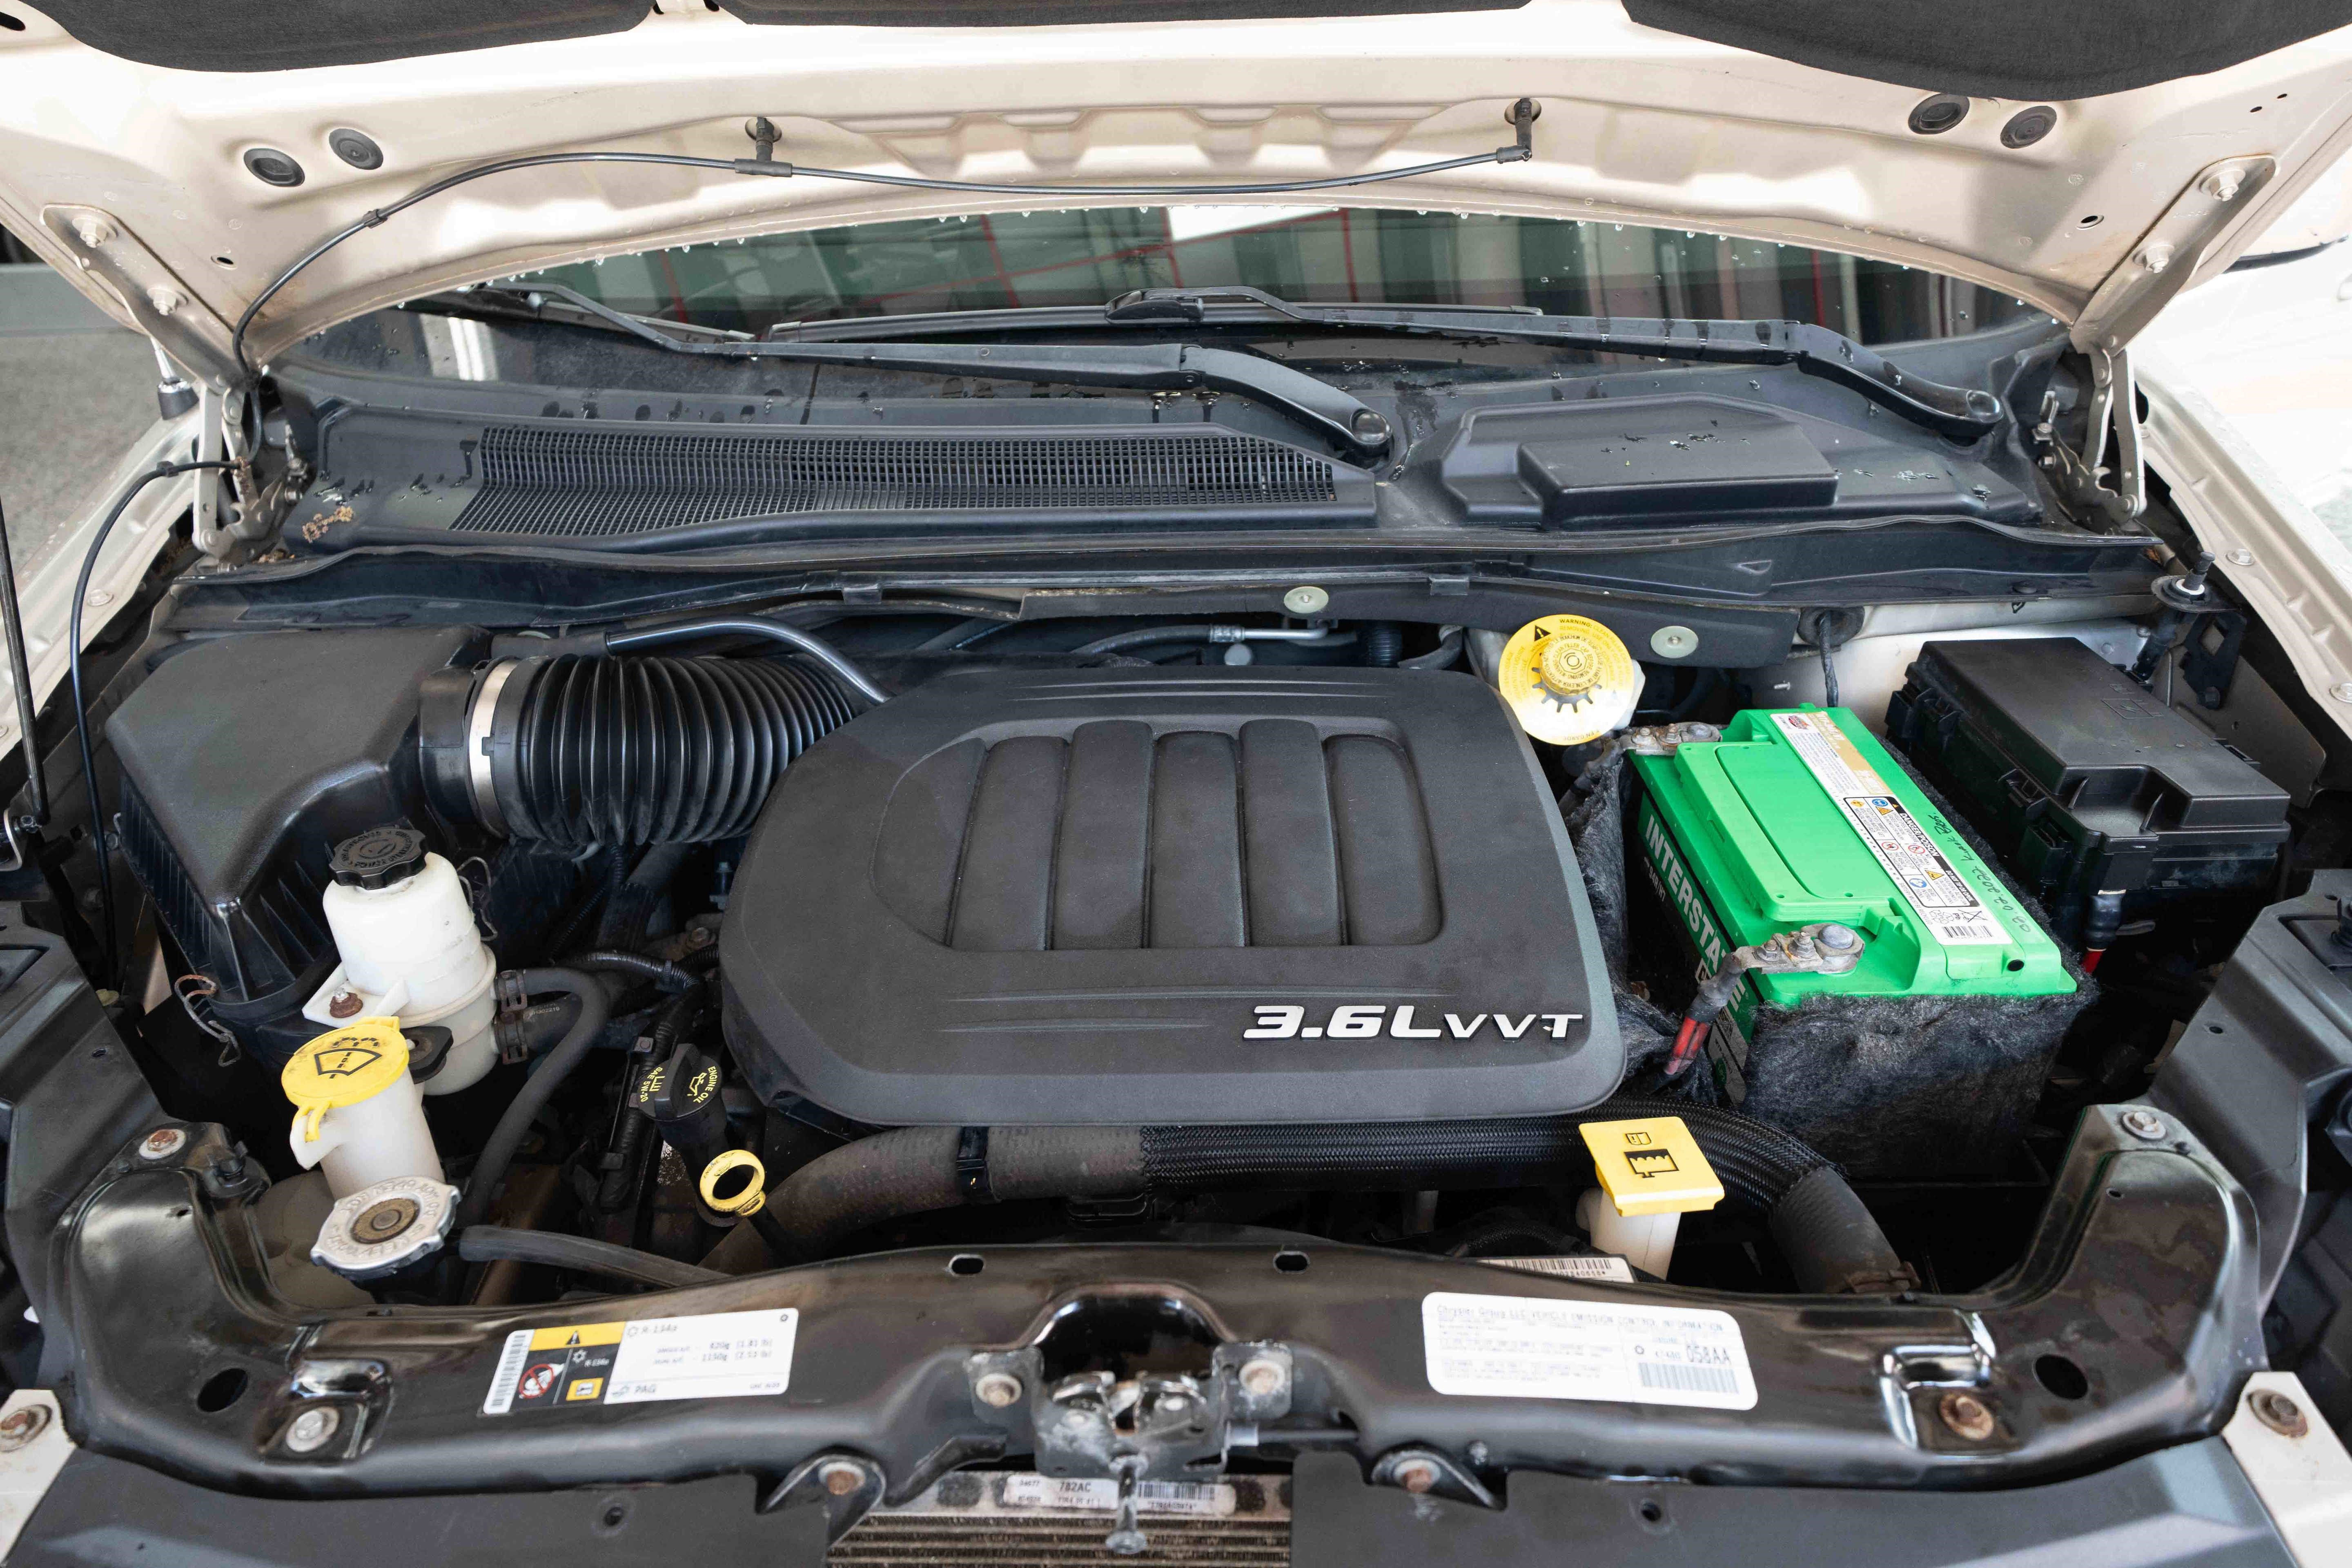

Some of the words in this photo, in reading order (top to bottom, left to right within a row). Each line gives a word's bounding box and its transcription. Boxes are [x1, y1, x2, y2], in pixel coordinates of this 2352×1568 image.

[1559, 619, 1593, 628] WARNING:
[1898, 813, 1940, 857] DANGER/POISON
[1243, 1005, 1442, 1040] 3.6L
[1444, 1014, 1584, 1041] VVT
[647, 1067, 663, 1080] SAE
[704, 1066, 717, 1092] ENGINE
[640, 1081, 651, 1102] 5W-20
[693, 1092, 709, 1103] OIL
[635, 1384, 657, 1394] PAG
